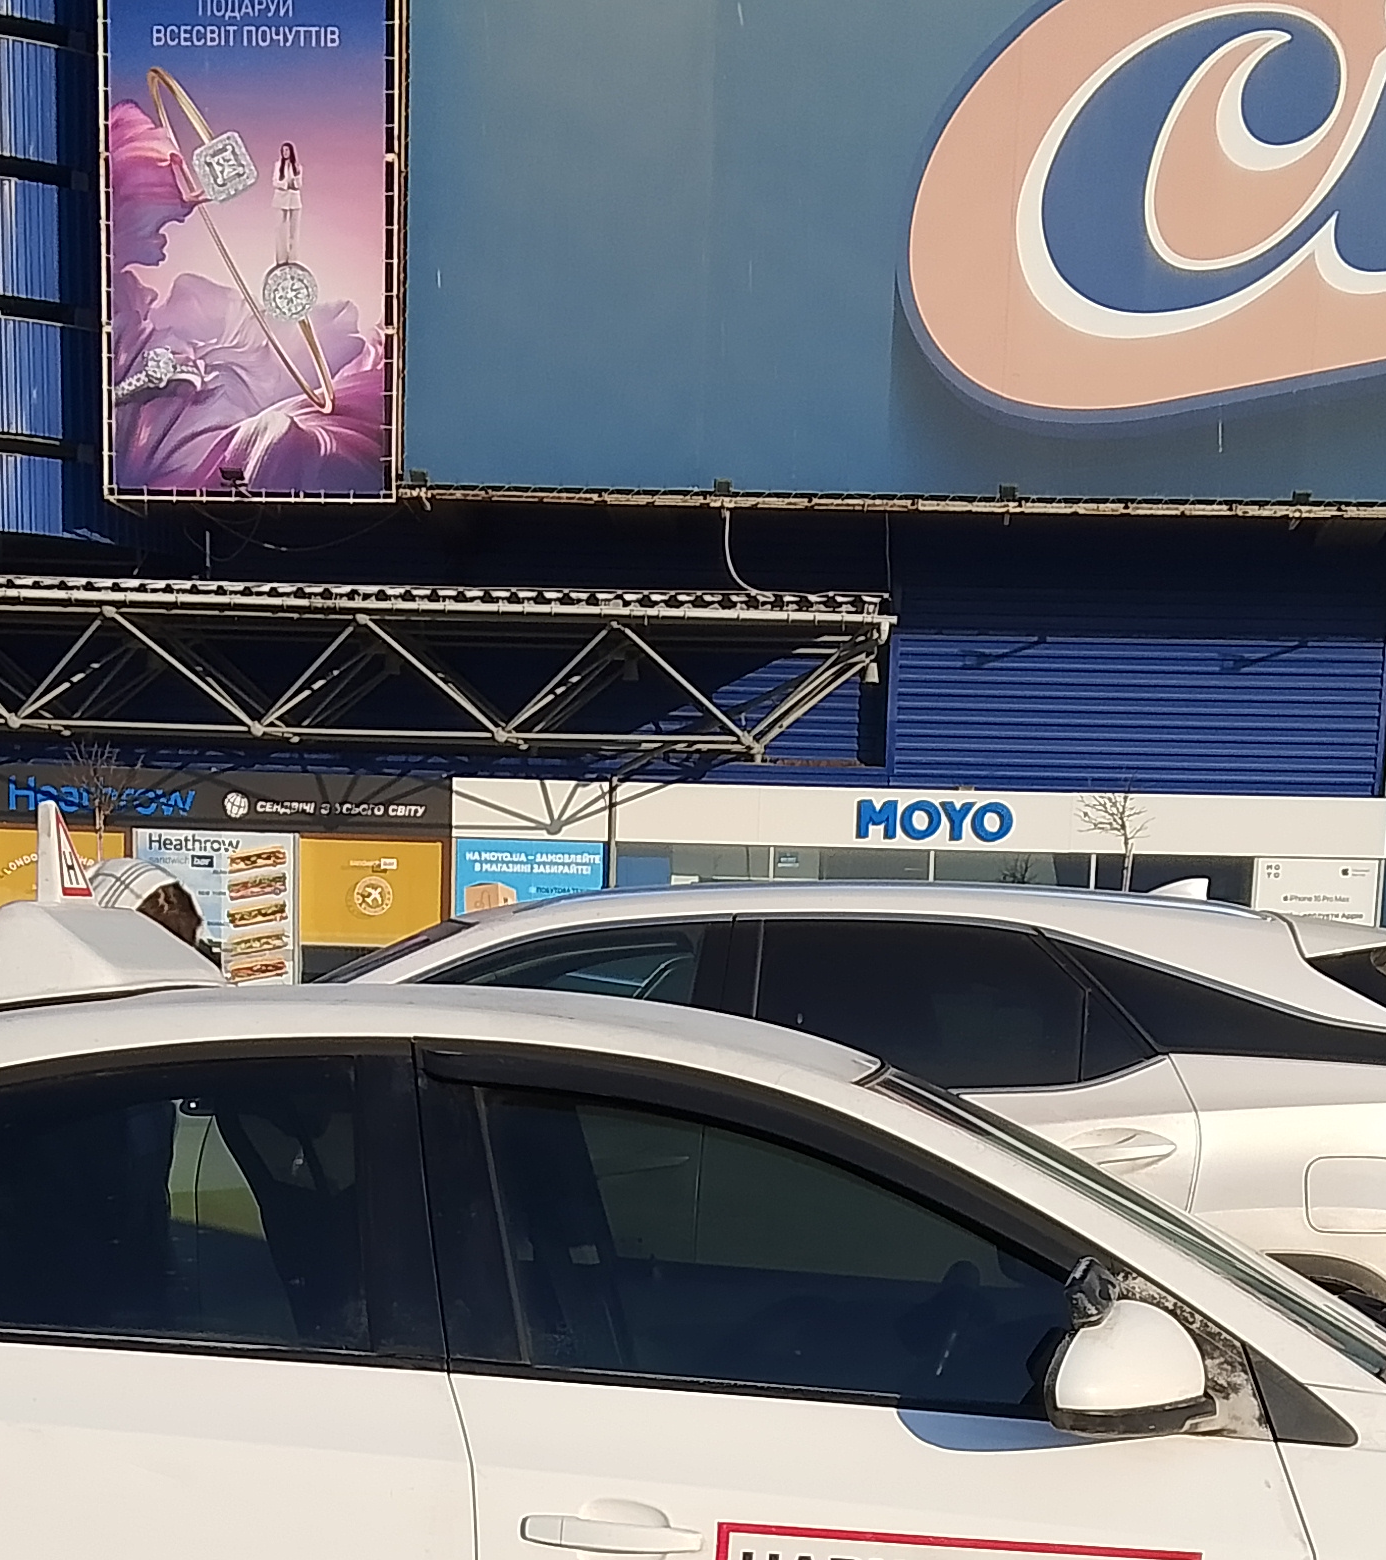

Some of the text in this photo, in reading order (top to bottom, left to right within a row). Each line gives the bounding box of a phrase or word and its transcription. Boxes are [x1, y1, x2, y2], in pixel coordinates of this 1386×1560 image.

[153, 26, 340, 47] ВСЕСВІТ ПОЧУТТІВ
[855, 799, 1013, 842] MOYO
[148, 833, 240, 853] Heathrow
